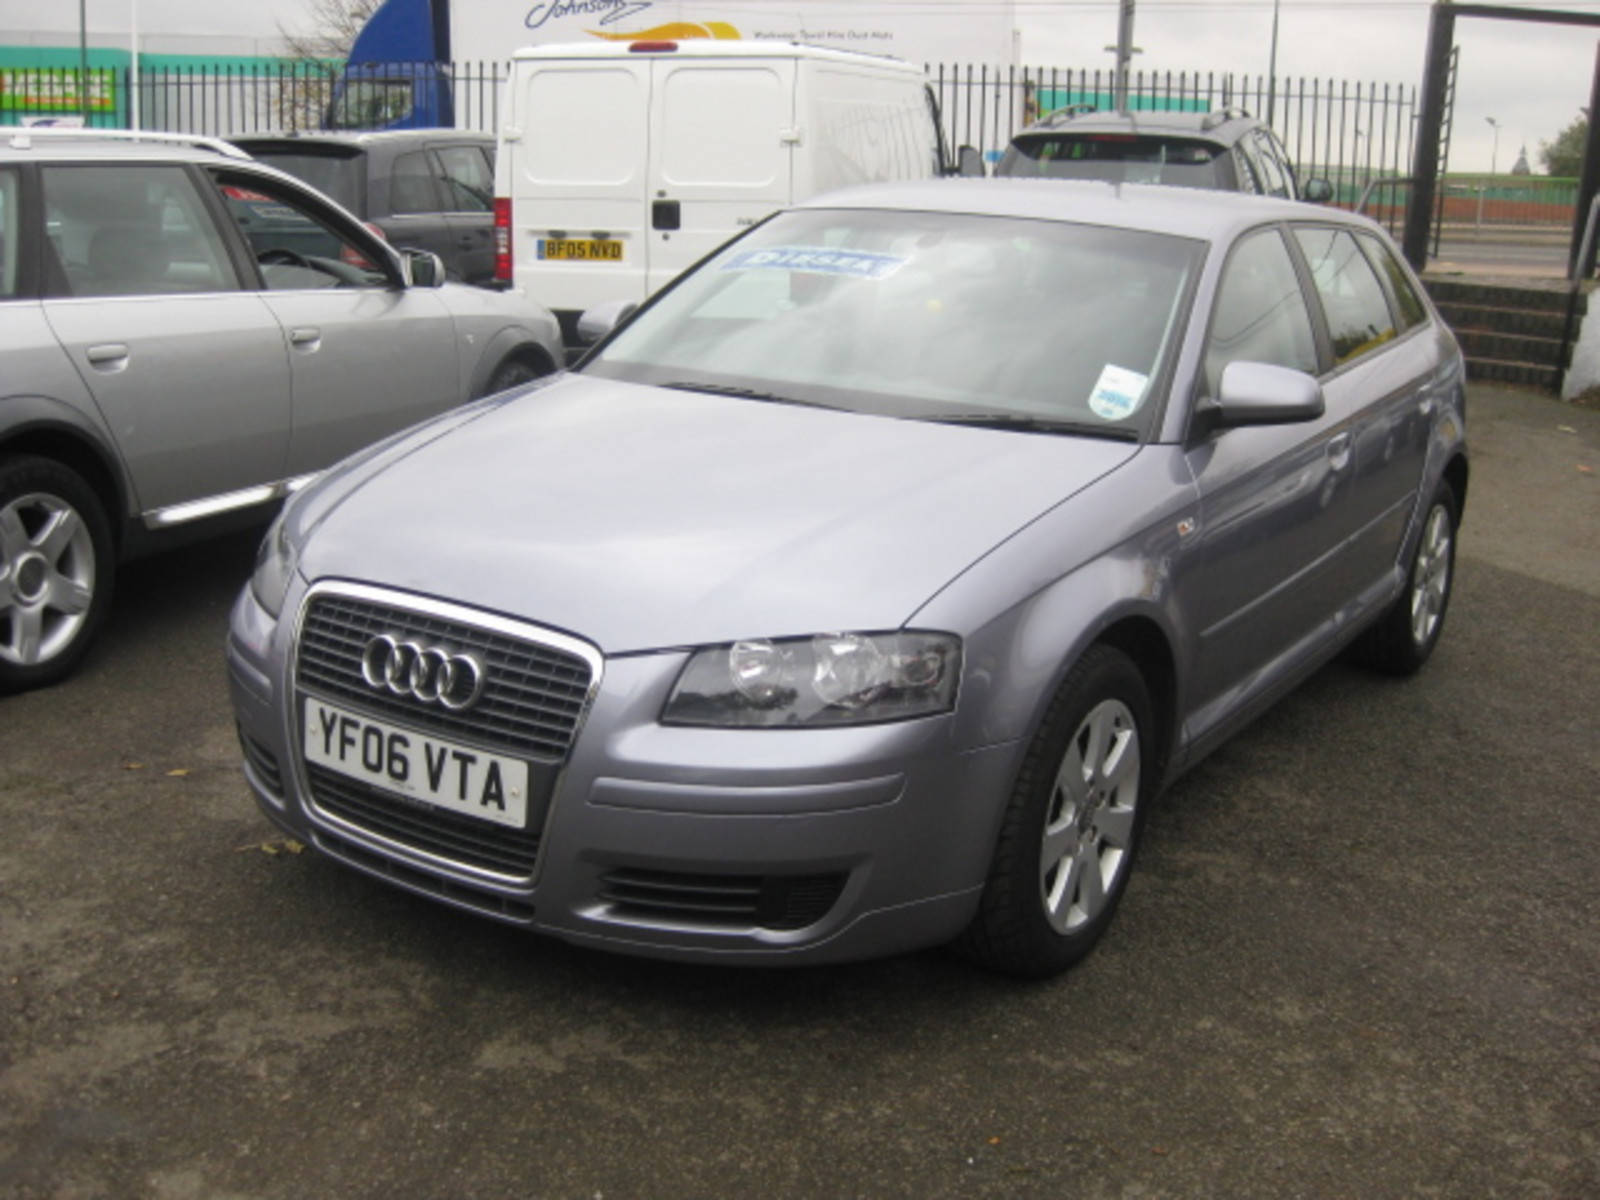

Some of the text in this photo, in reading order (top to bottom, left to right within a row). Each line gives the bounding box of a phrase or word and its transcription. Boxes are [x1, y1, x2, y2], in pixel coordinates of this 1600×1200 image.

[546, 241, 586, 257] BF05
[319, 706, 506, 812] YF06 VTA
